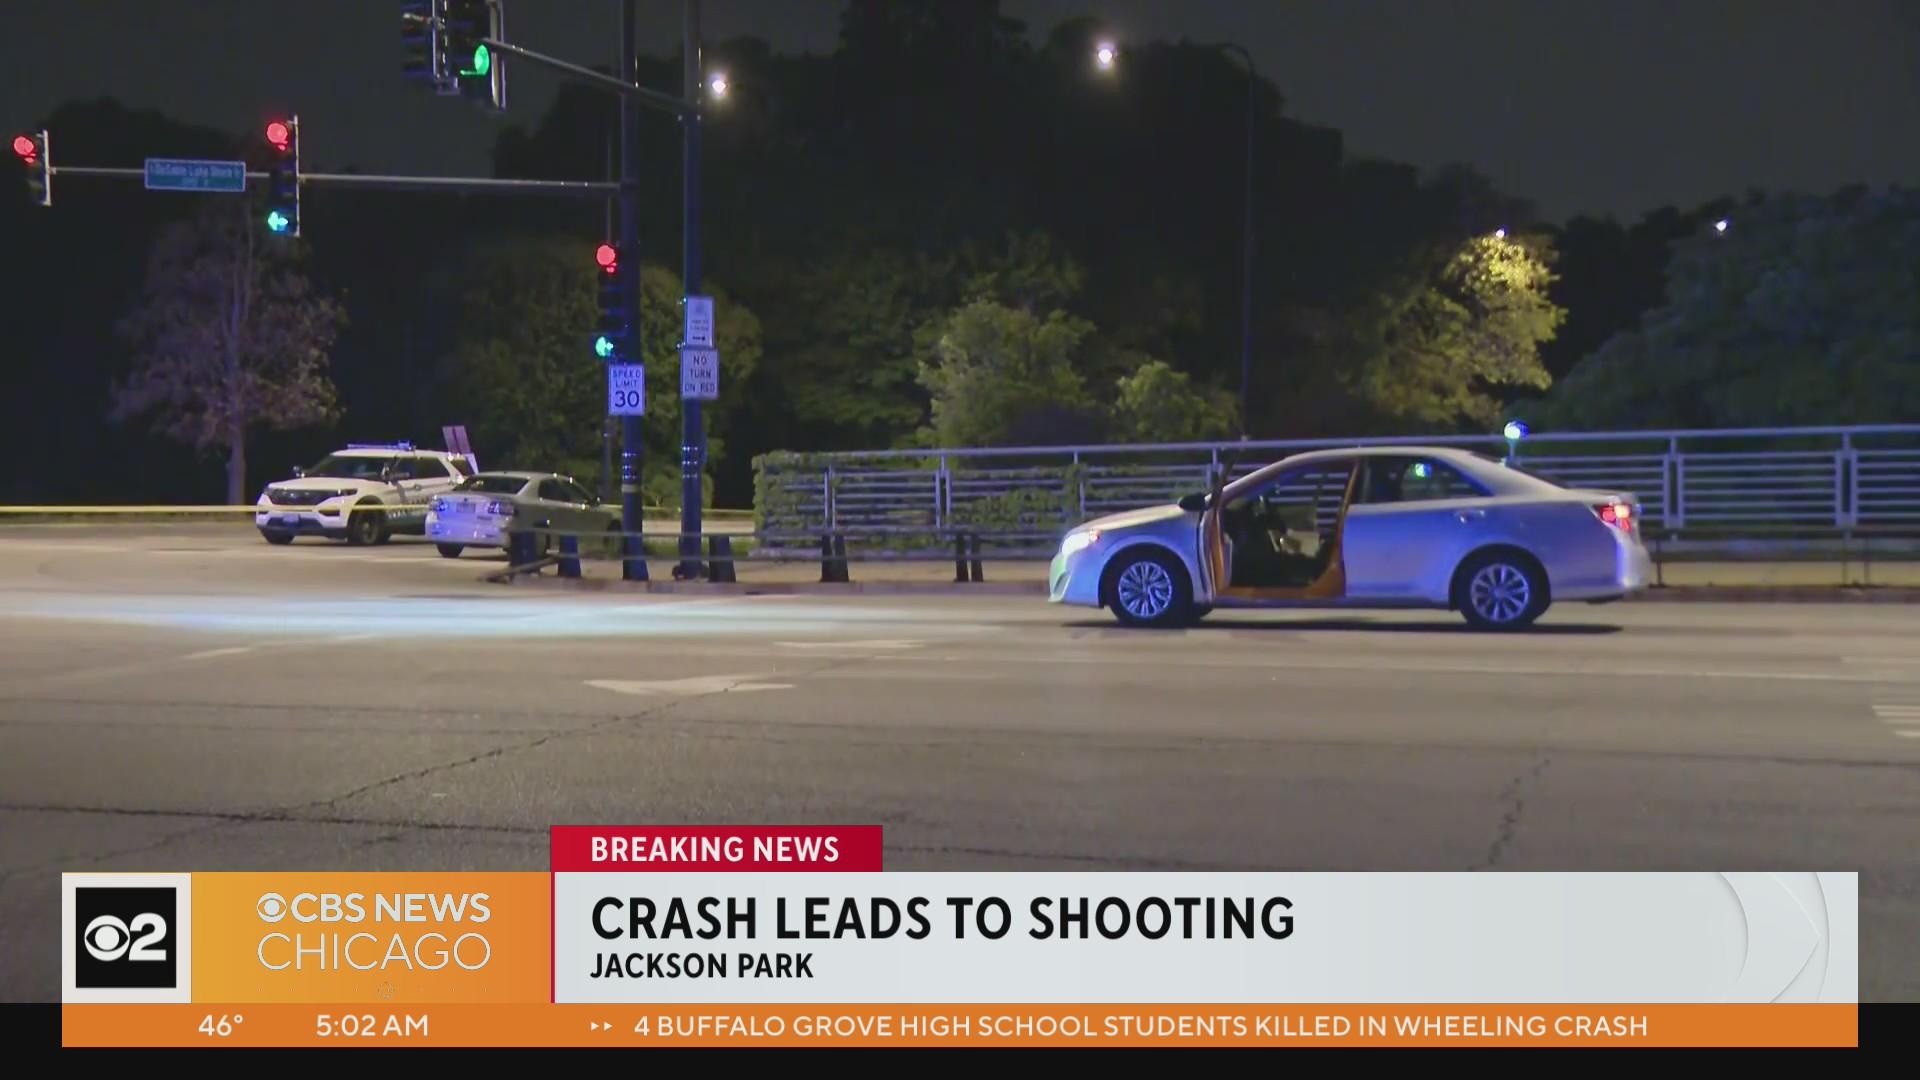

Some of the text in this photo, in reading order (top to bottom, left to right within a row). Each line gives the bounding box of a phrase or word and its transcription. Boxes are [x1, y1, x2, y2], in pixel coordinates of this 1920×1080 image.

[693, 355, 707, 365] NO
[612, 368, 642, 378] SPEED
[690, 368, 711, 379] TURN
[615, 379, 638, 388] LIMIT
[684, 383, 716, 393] ON RED
[615, 390, 640, 408] 30
